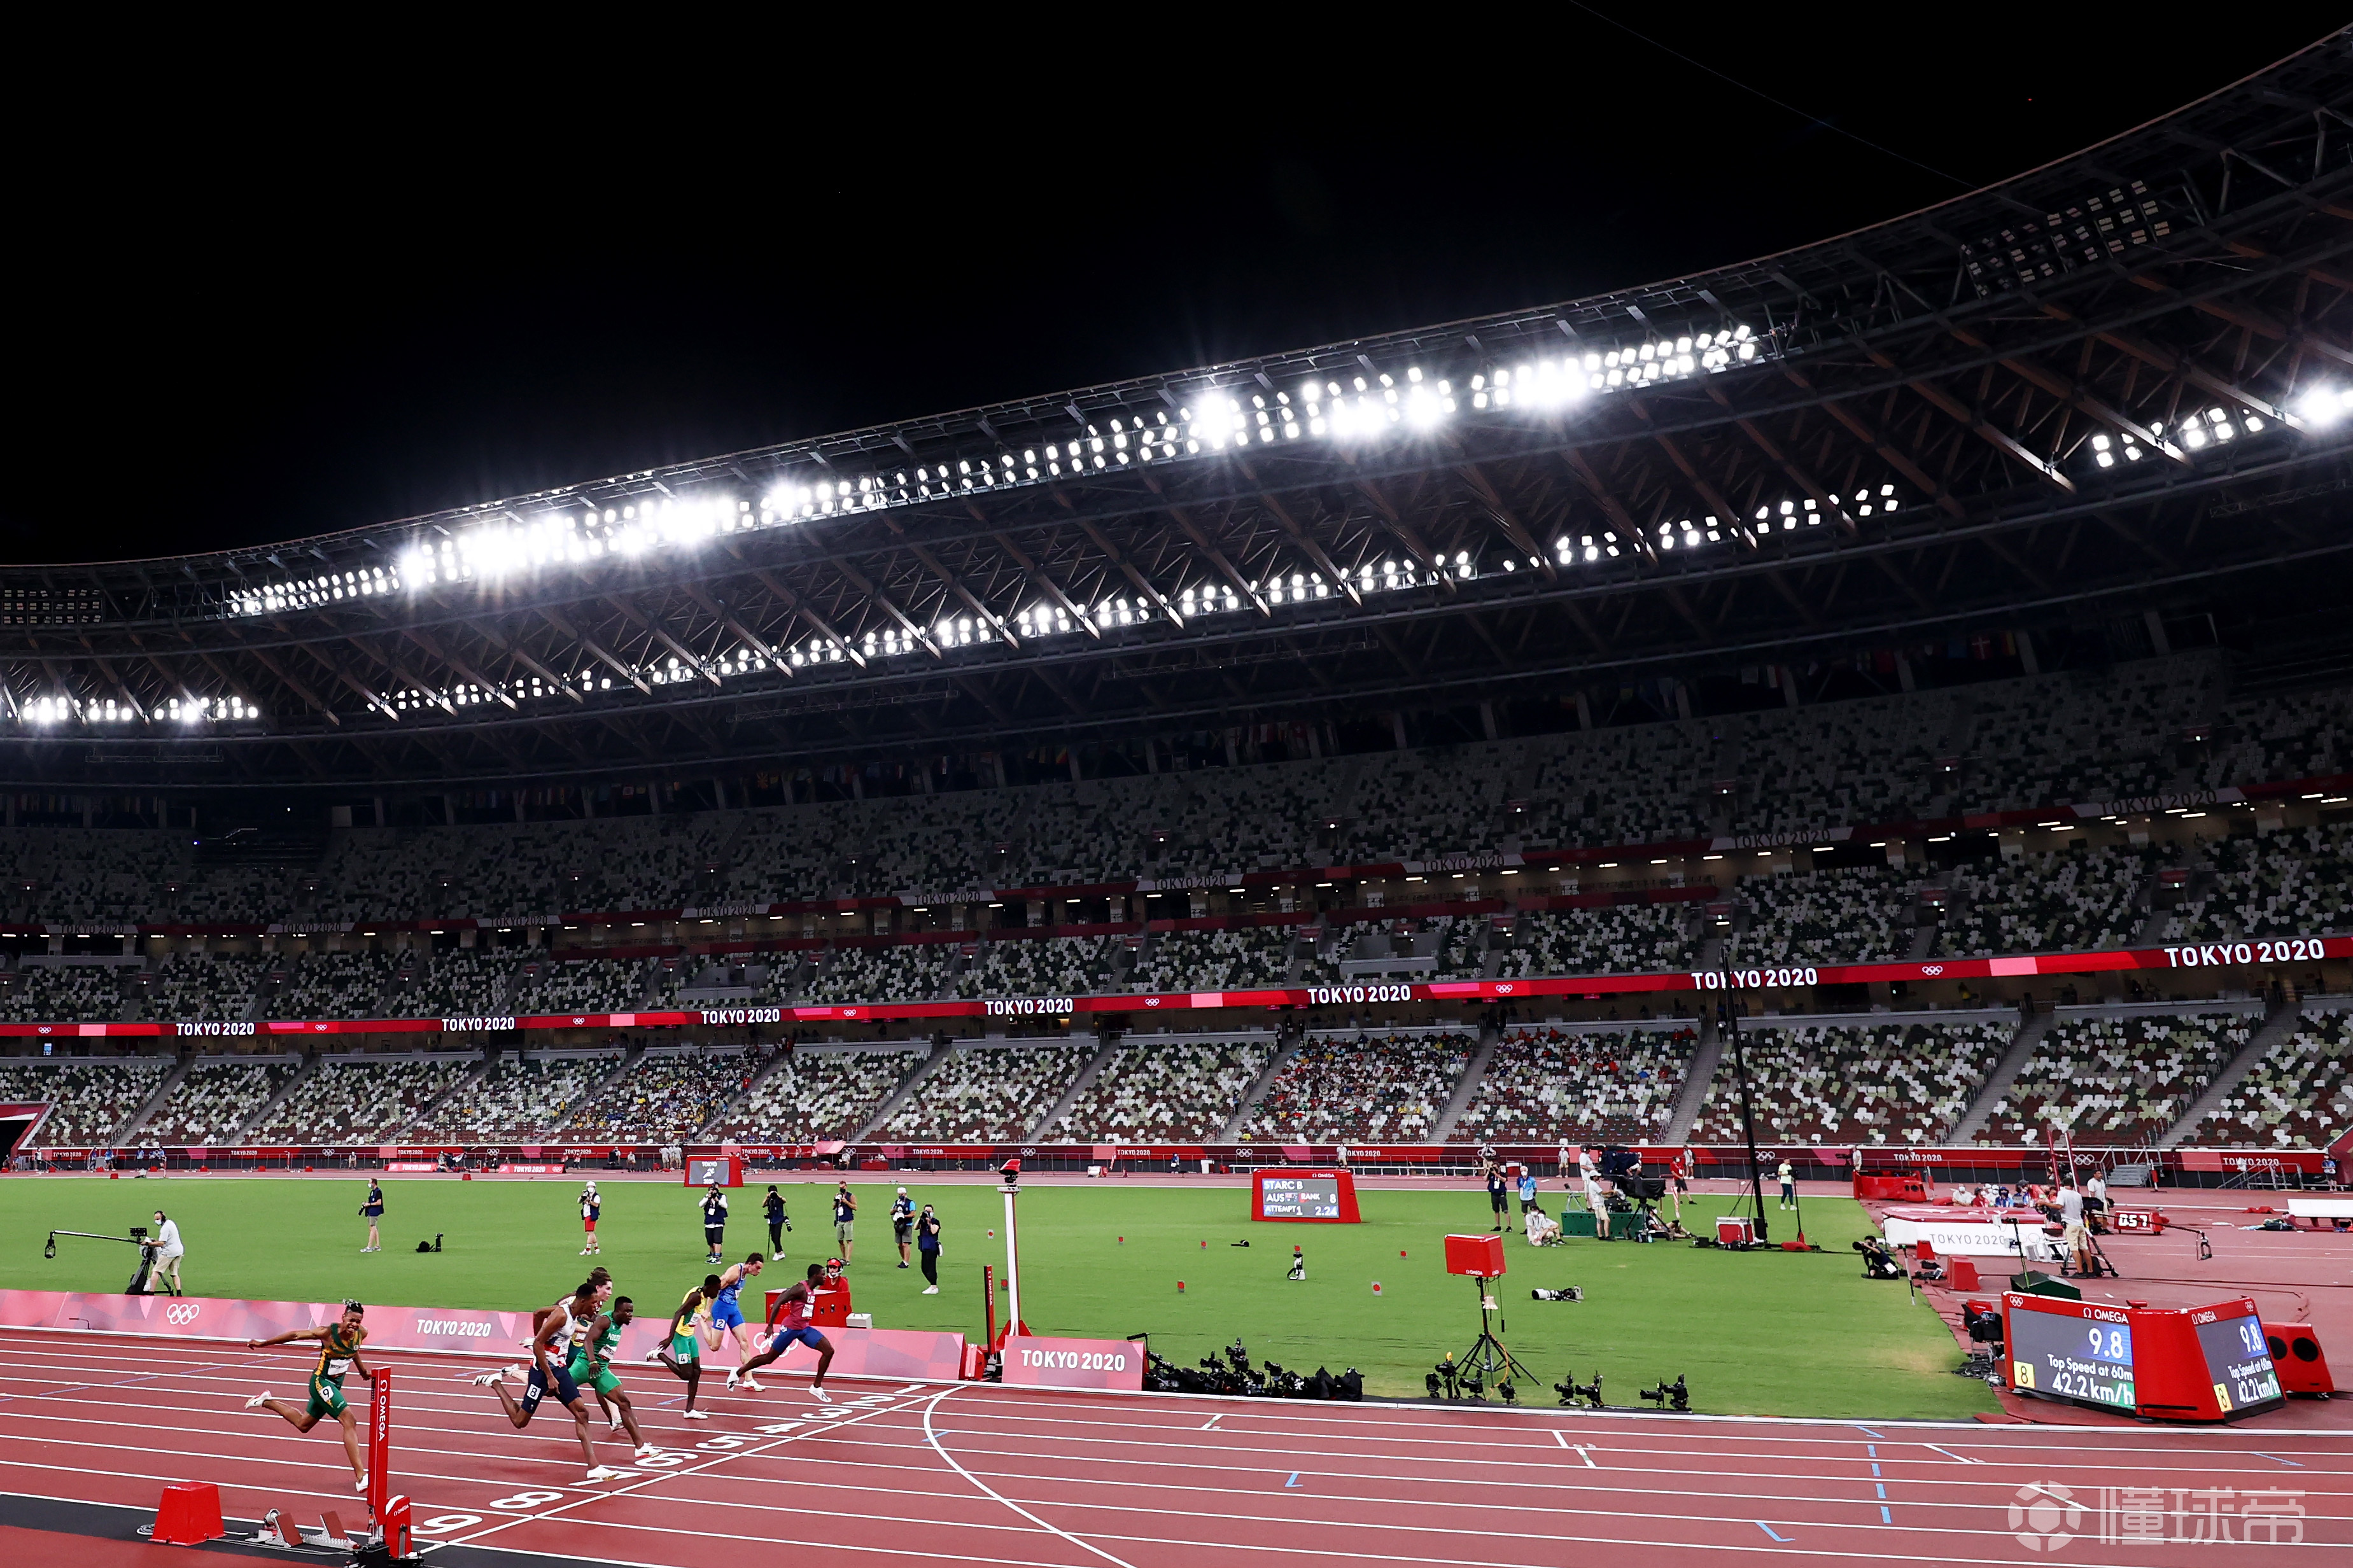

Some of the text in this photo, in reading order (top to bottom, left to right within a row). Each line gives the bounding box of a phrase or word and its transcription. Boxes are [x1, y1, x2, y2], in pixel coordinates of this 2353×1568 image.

[2099, 790, 2216, 815] TOKYO 2020
[1734, 829, 1830, 848] TOKYO 2020
[1422, 855, 1504, 872] TOKYO 2020
[1153, 876, 1226, 890] TOKYO 2020
[915, 892, 980, 905] TOKYO 2020
[696, 904, 756, 916] TOKYO 2020
[60, 924, 124, 934] TOKYO 2020
[281, 921, 341, 933] TOKYO 2020
[490, 916, 547, 927] TOKYO 2020
[2164, 939, 2324, 967] TOKYO 2020
[1691, 967, 1818, 990] TOKYO 2020
[1307, 984, 1410, 1004] TOKYO 2020
[985, 998, 1073, 1016] TOKYO 2020
[441, 1016, 515, 1032] TOKYO 2020
[701, 1008, 780, 1025] TOKYO 2020
[176, 1022, 255, 1036] TOKYO 2020
[2256, 1158, 2279, 1166] 2020
[1263, 1180, 1303, 1190] STARC B
[1266, 1193, 1285, 1202] AUS
[1330, 1193, 1337, 1203] 8
[1296, 1206, 1303, 1215] 1
[1315, 1206, 1338, 1216] 2.24
[1929, 1233, 2005, 1245] TOKYO 2020
[2094, 1309, 2128, 1324] OMEGA
[2197, 1311, 2217, 1324] OMEGA
[417, 1319, 491, 1338] TOKYO 2020
[2089, 1328, 2123, 1359] 9.8
[2239, 1323, 2262, 1352] 9.8
[1021, 1349, 1125, 1371] TOKYO 2020
[2020, 1365, 2028, 1384] 8
[2047, 1354, 2133, 1382] Top Speed at 60m
[2228, 1365, 2240, 1382] Top
[2238, 1361, 2255, 1380] Speed
[2260, 1357, 2273, 1371] 60m
[323, 1389, 330, 1397] 9
[530, 1387, 538, 1397] 8
[894, 1384, 928, 1394] 1
[2052, 1371, 2135, 1406] 42.2 km/h
[2238, 1373, 2281, 1404] 42.2 km/h
[841, 1396, 896, 1406] 2
[2219, 1387, 2228, 1408] 8
[800, 1408, 853, 1420] 3
[753, 1422, 806, 1433] 4
[696, 1435, 761, 1450] 5
[635, 1452, 699, 1467] 6
[489, 1491, 564, 1509] 8
[411, 1515, 483, 1534] 9
